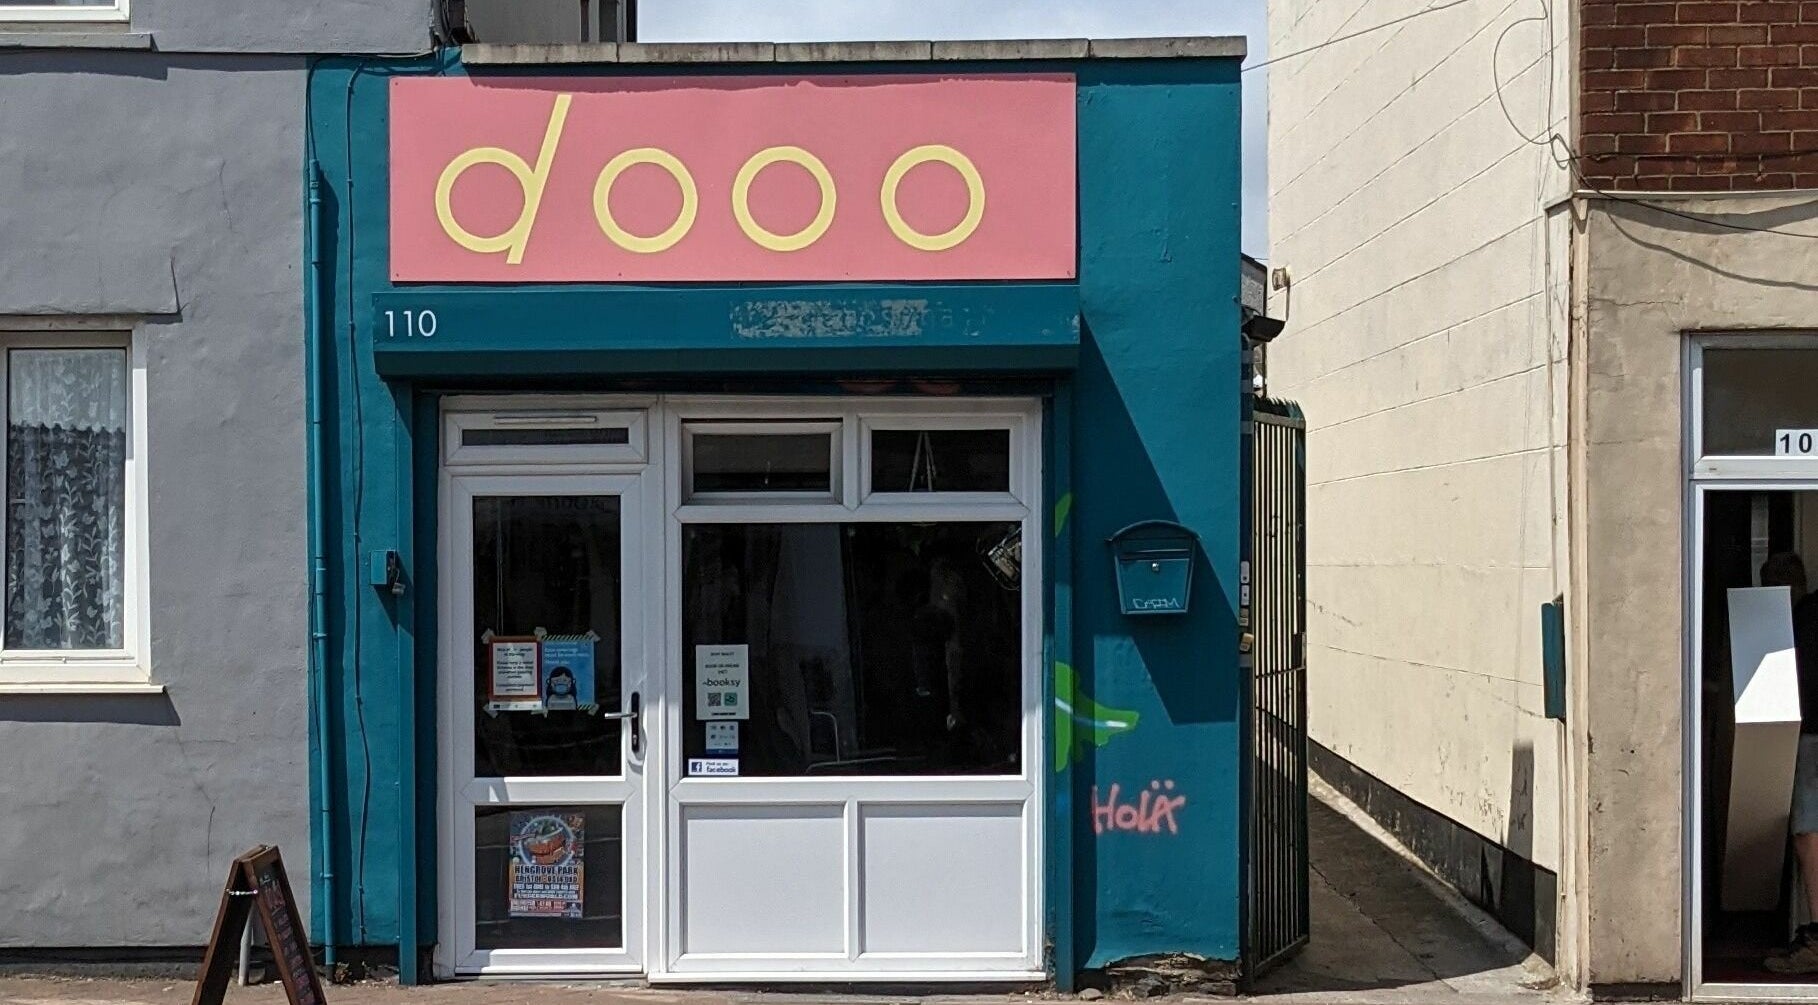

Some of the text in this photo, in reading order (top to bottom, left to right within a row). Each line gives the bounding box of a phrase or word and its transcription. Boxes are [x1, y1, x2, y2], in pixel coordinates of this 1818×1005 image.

[385, 310, 437, 337] 110
[706, 678, 741, 687] booksy
[557, 865, 578, 875] PARK
